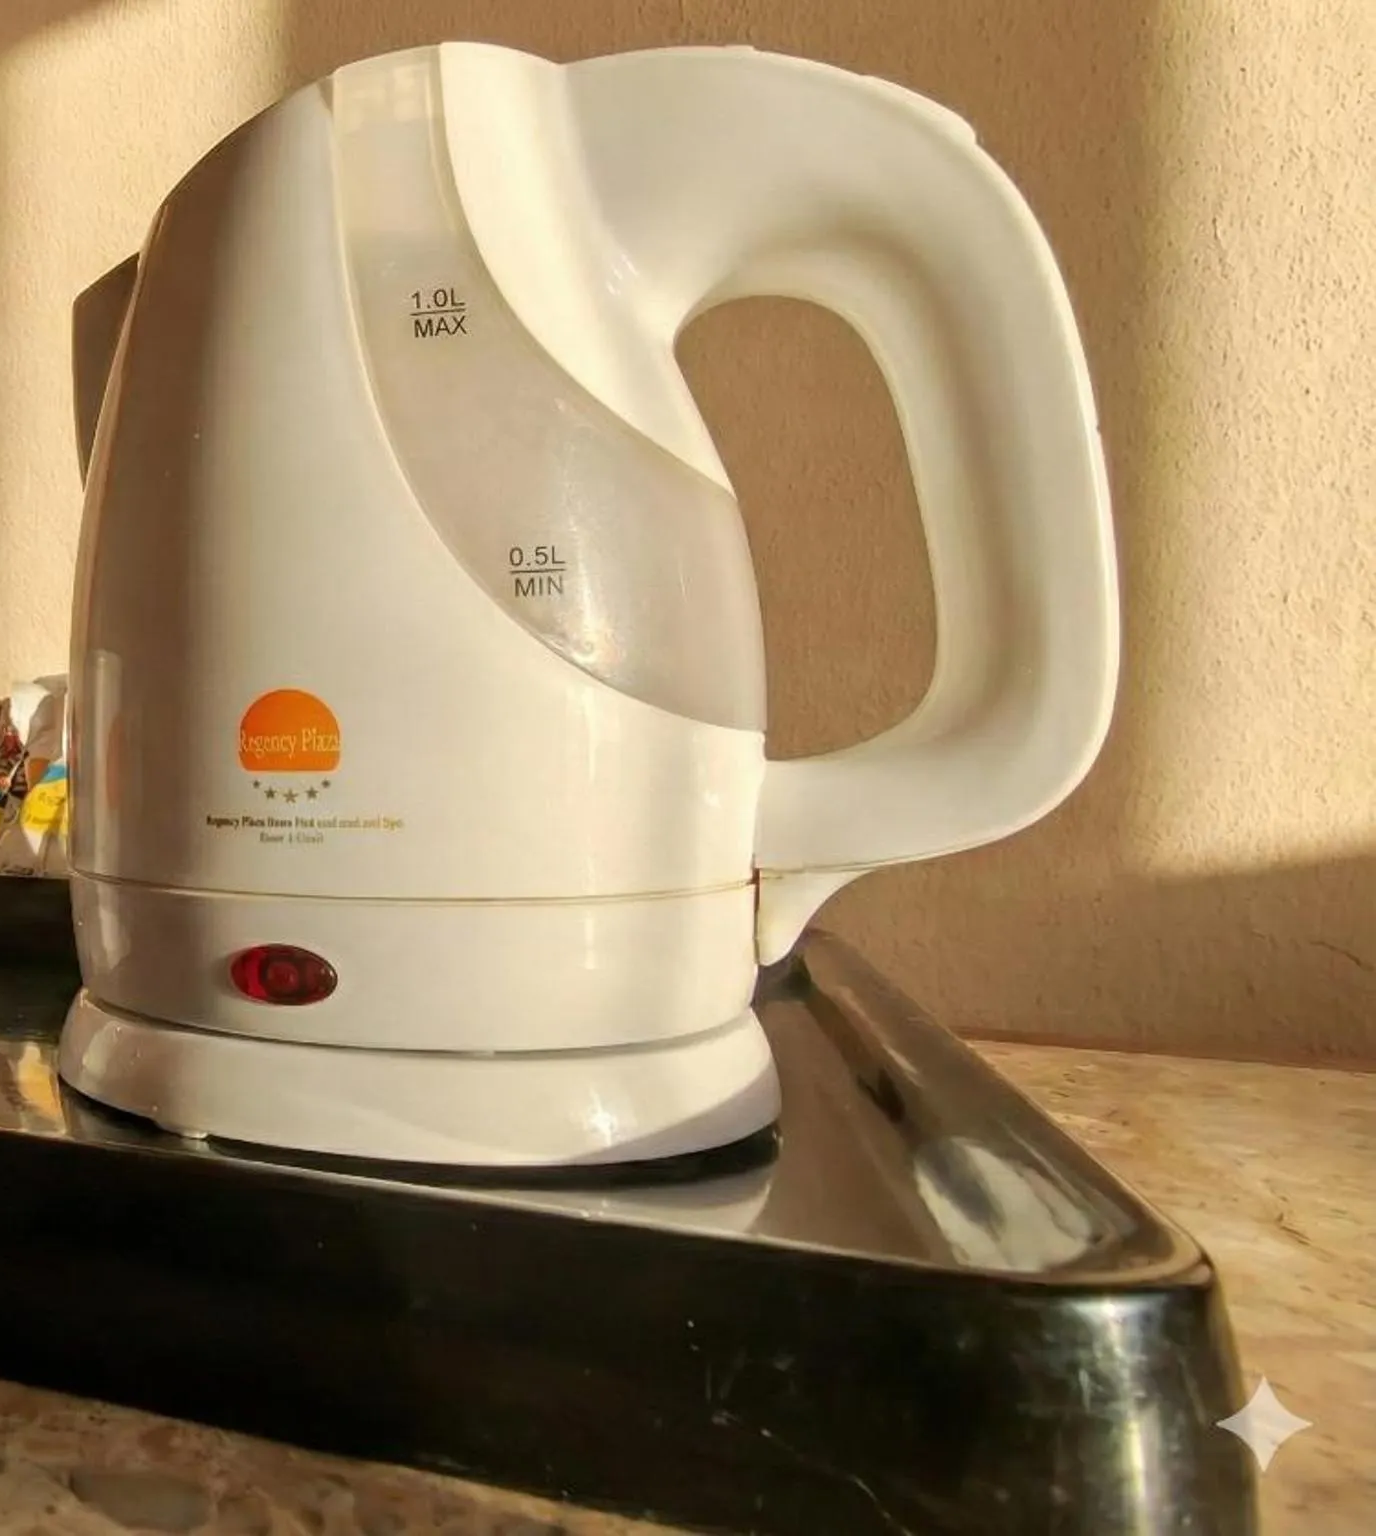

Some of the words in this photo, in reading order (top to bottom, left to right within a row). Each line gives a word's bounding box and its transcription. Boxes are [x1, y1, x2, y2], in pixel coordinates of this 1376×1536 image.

[410, 288, 466, 309] 1.0L
[413, 315, 468, 338] MAX
[509, 546, 566, 567] 0.5L
[514, 575, 565, 598] MIN
